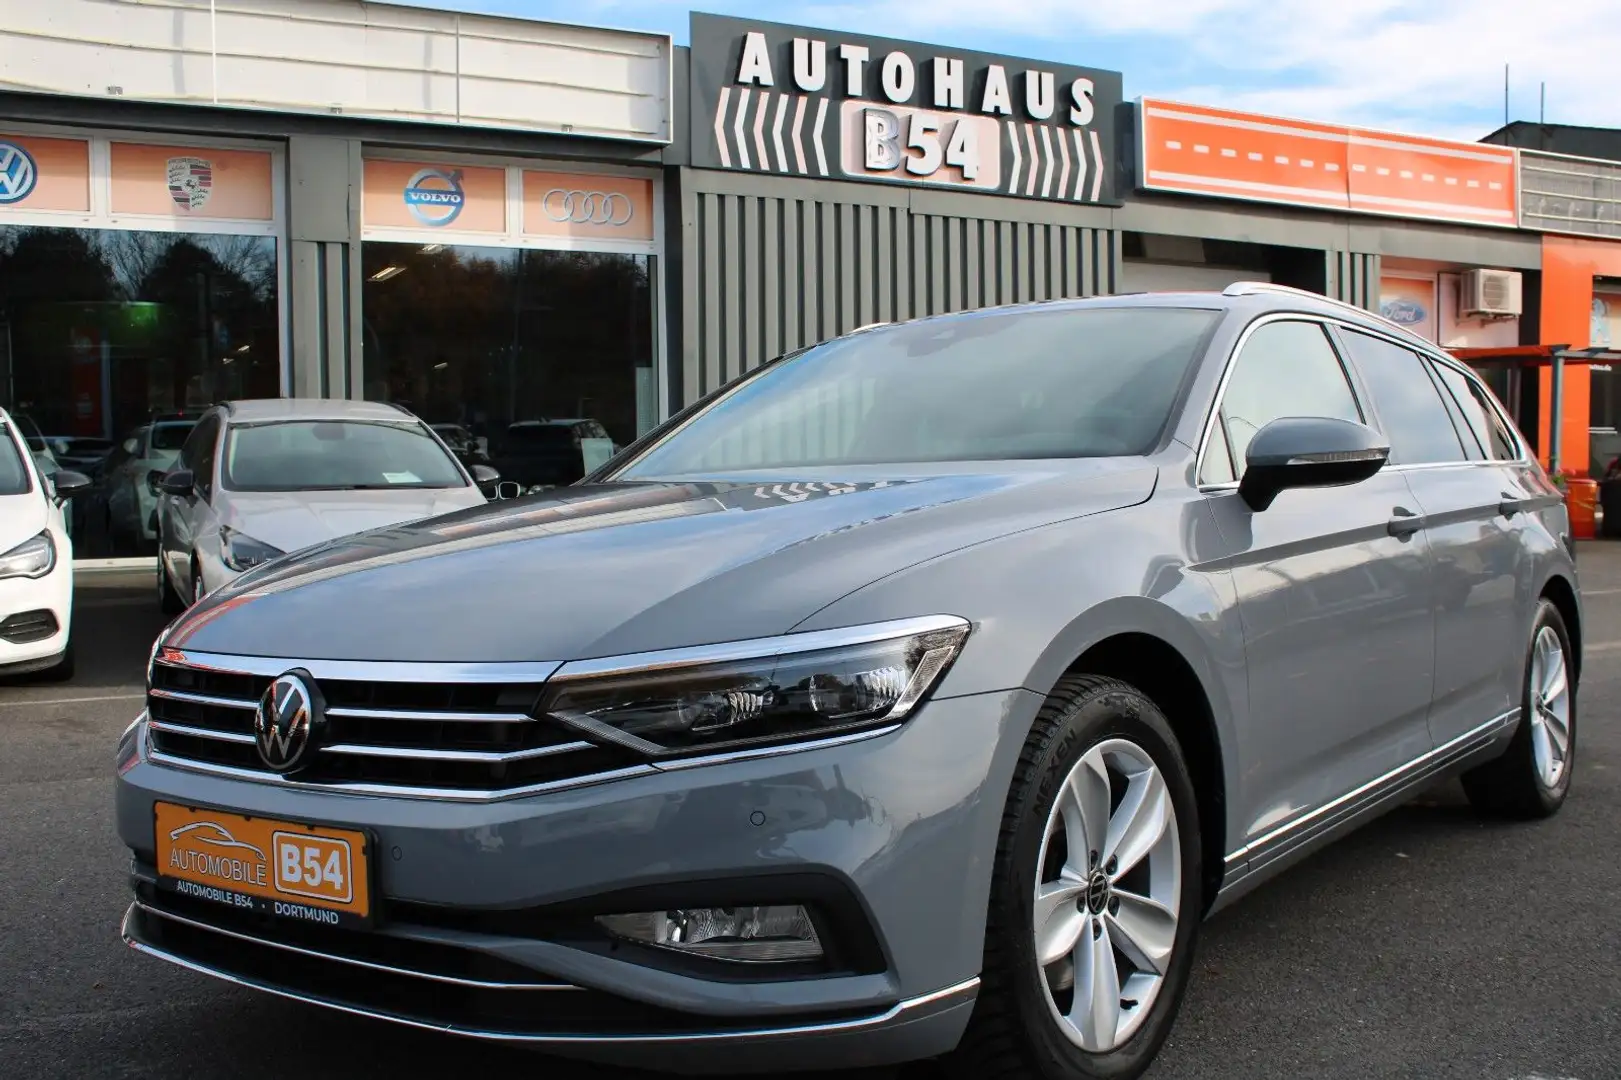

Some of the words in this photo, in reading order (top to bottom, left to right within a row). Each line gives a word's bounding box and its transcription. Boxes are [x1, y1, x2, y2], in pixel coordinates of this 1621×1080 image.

[737, 31, 1094, 126] AUTOHAUS
[863, 107, 979, 181] B54
[408, 191, 462, 203] VOLVO
[1383, 302, 1417, 322] Ford
[1033, 726, 1076, 816] NEXEN
[170, 847, 267, 887] AUTOMOBILE
[280, 843, 344, 890] B54
[176, 880, 233, 904] AUTOMOBILE
[234, 893, 254, 909] B54
[274, 902, 339, 925] DORTMUND
